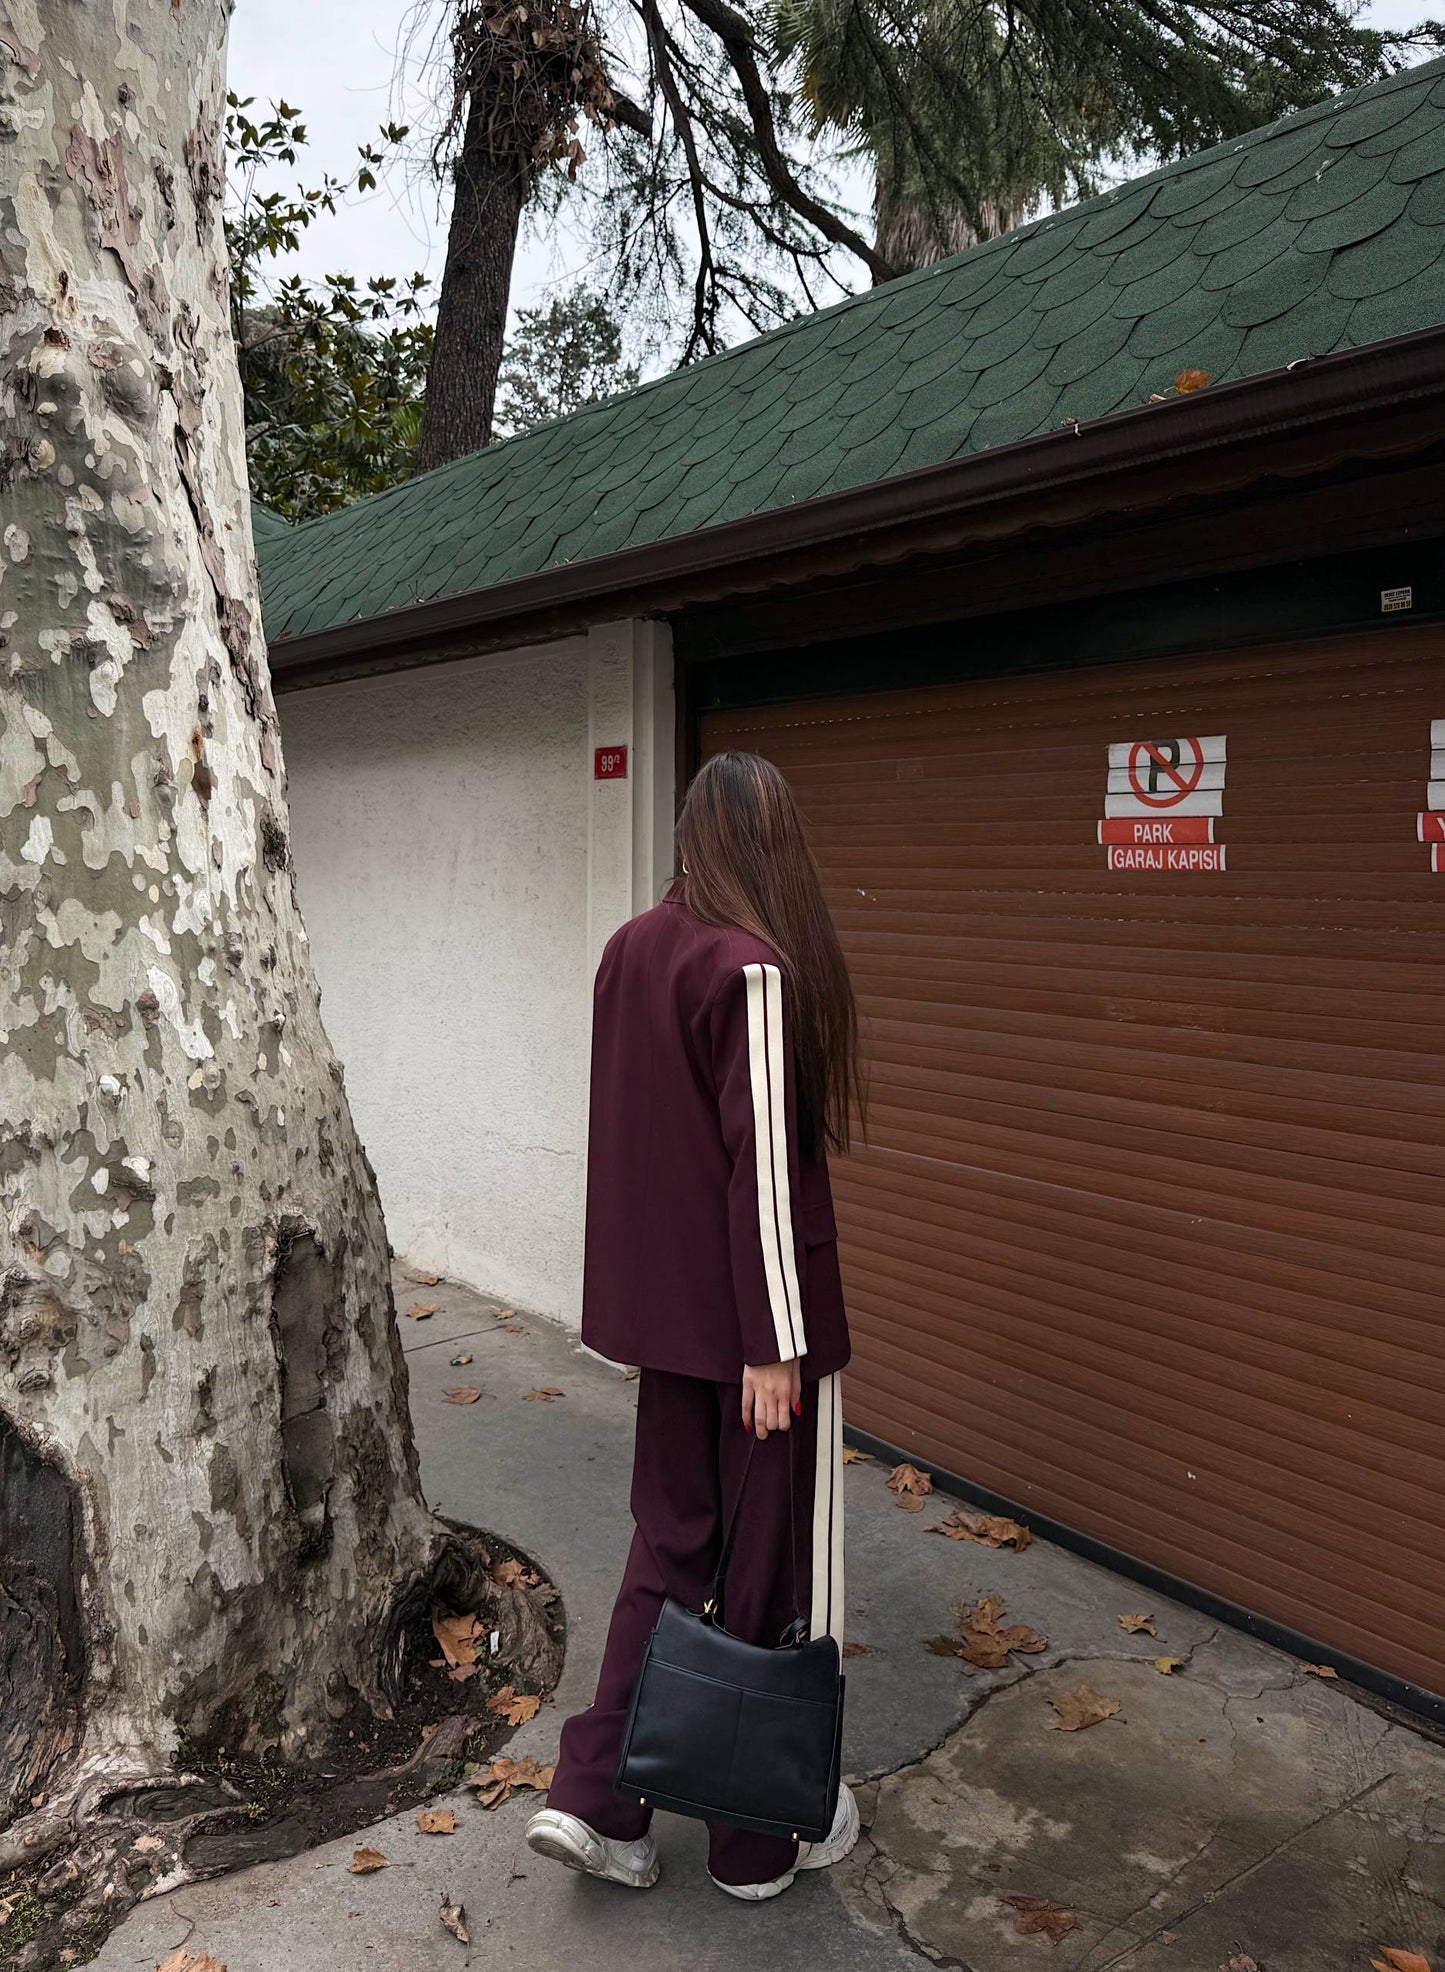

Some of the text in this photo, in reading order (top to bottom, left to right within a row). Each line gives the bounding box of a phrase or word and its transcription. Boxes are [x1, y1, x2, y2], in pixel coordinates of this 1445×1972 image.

[1133, 824, 1174, 843] PARK
[1113, 848, 1218, 870] GARAJ KAPISI
